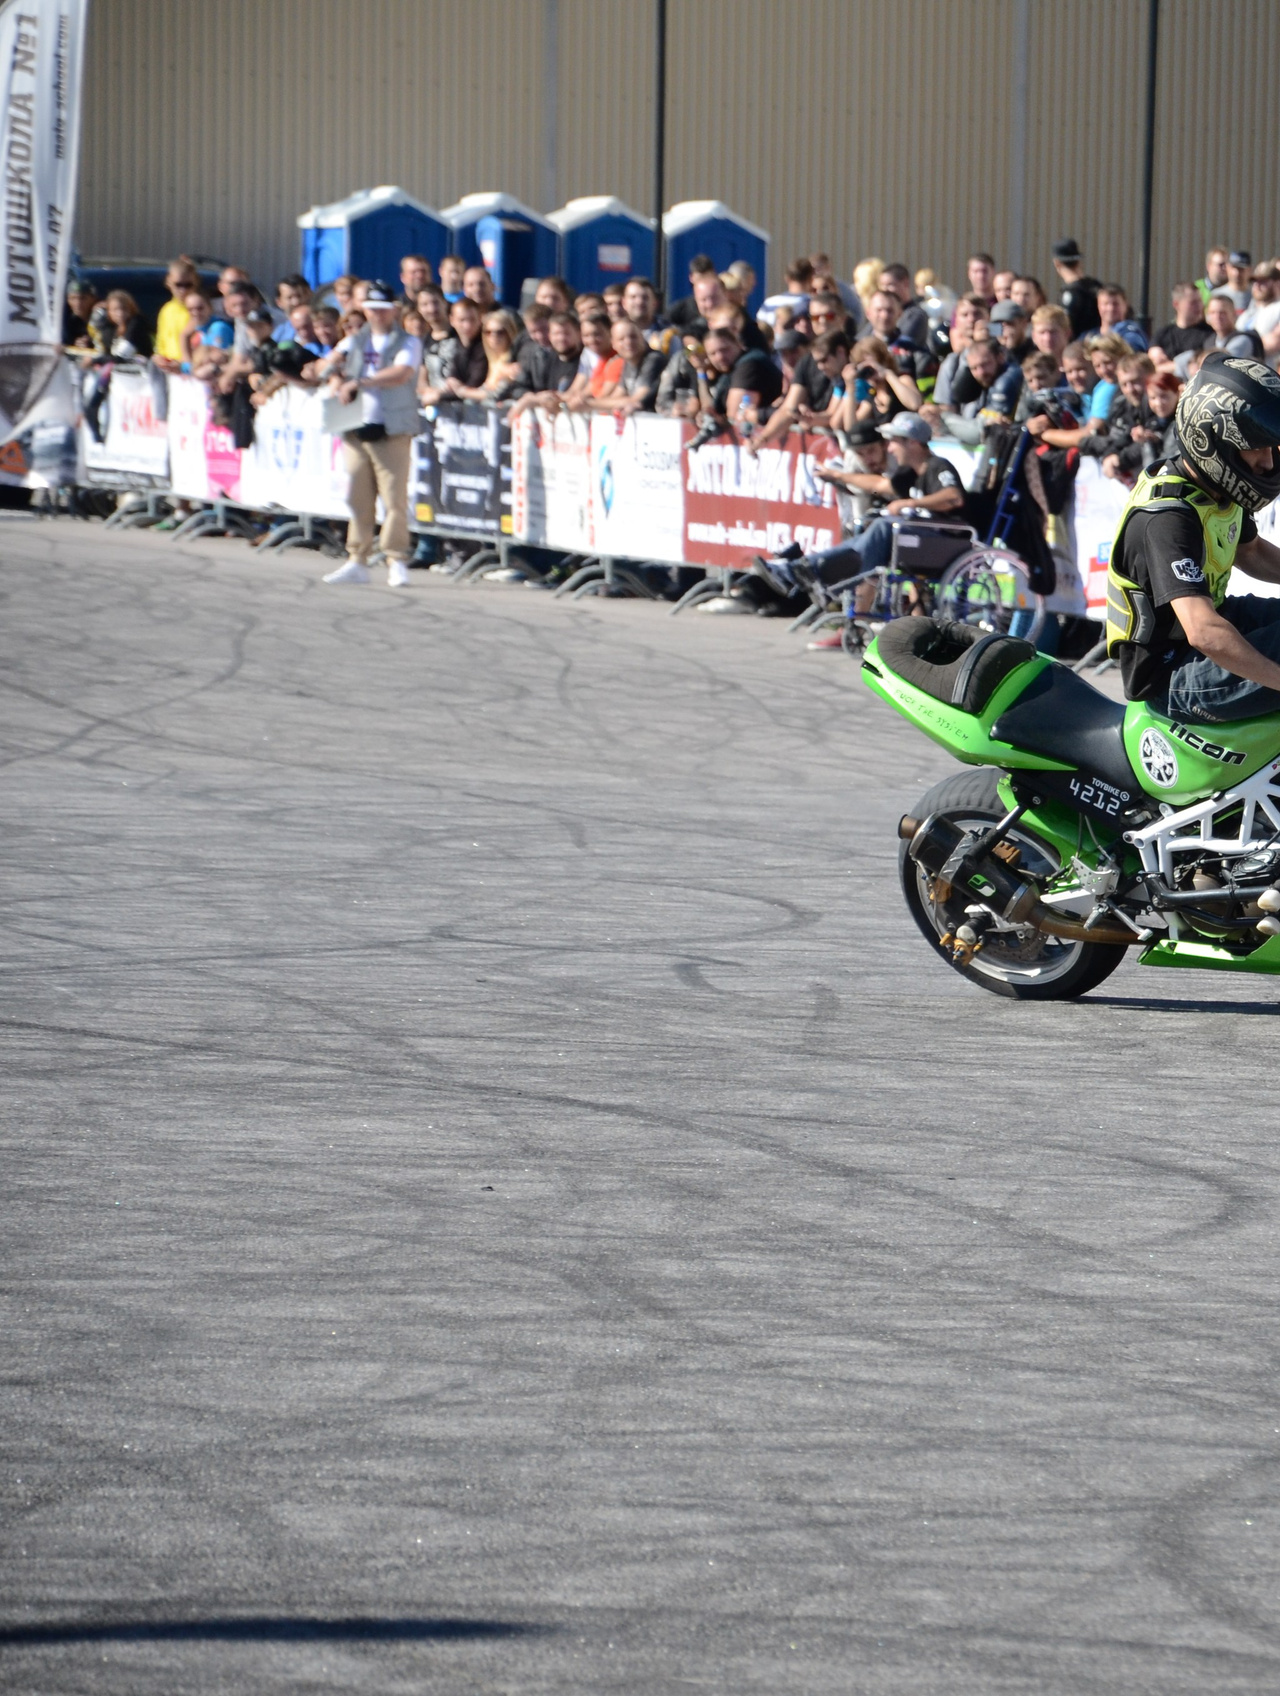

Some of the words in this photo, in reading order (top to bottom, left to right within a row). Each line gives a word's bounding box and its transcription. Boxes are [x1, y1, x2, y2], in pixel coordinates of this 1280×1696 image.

[7, 92, 36, 326] МОТОШКОЛА
[1069, 778, 1120, 816] 4212
[1091, 776, 1121, 797] TOYBIKE
